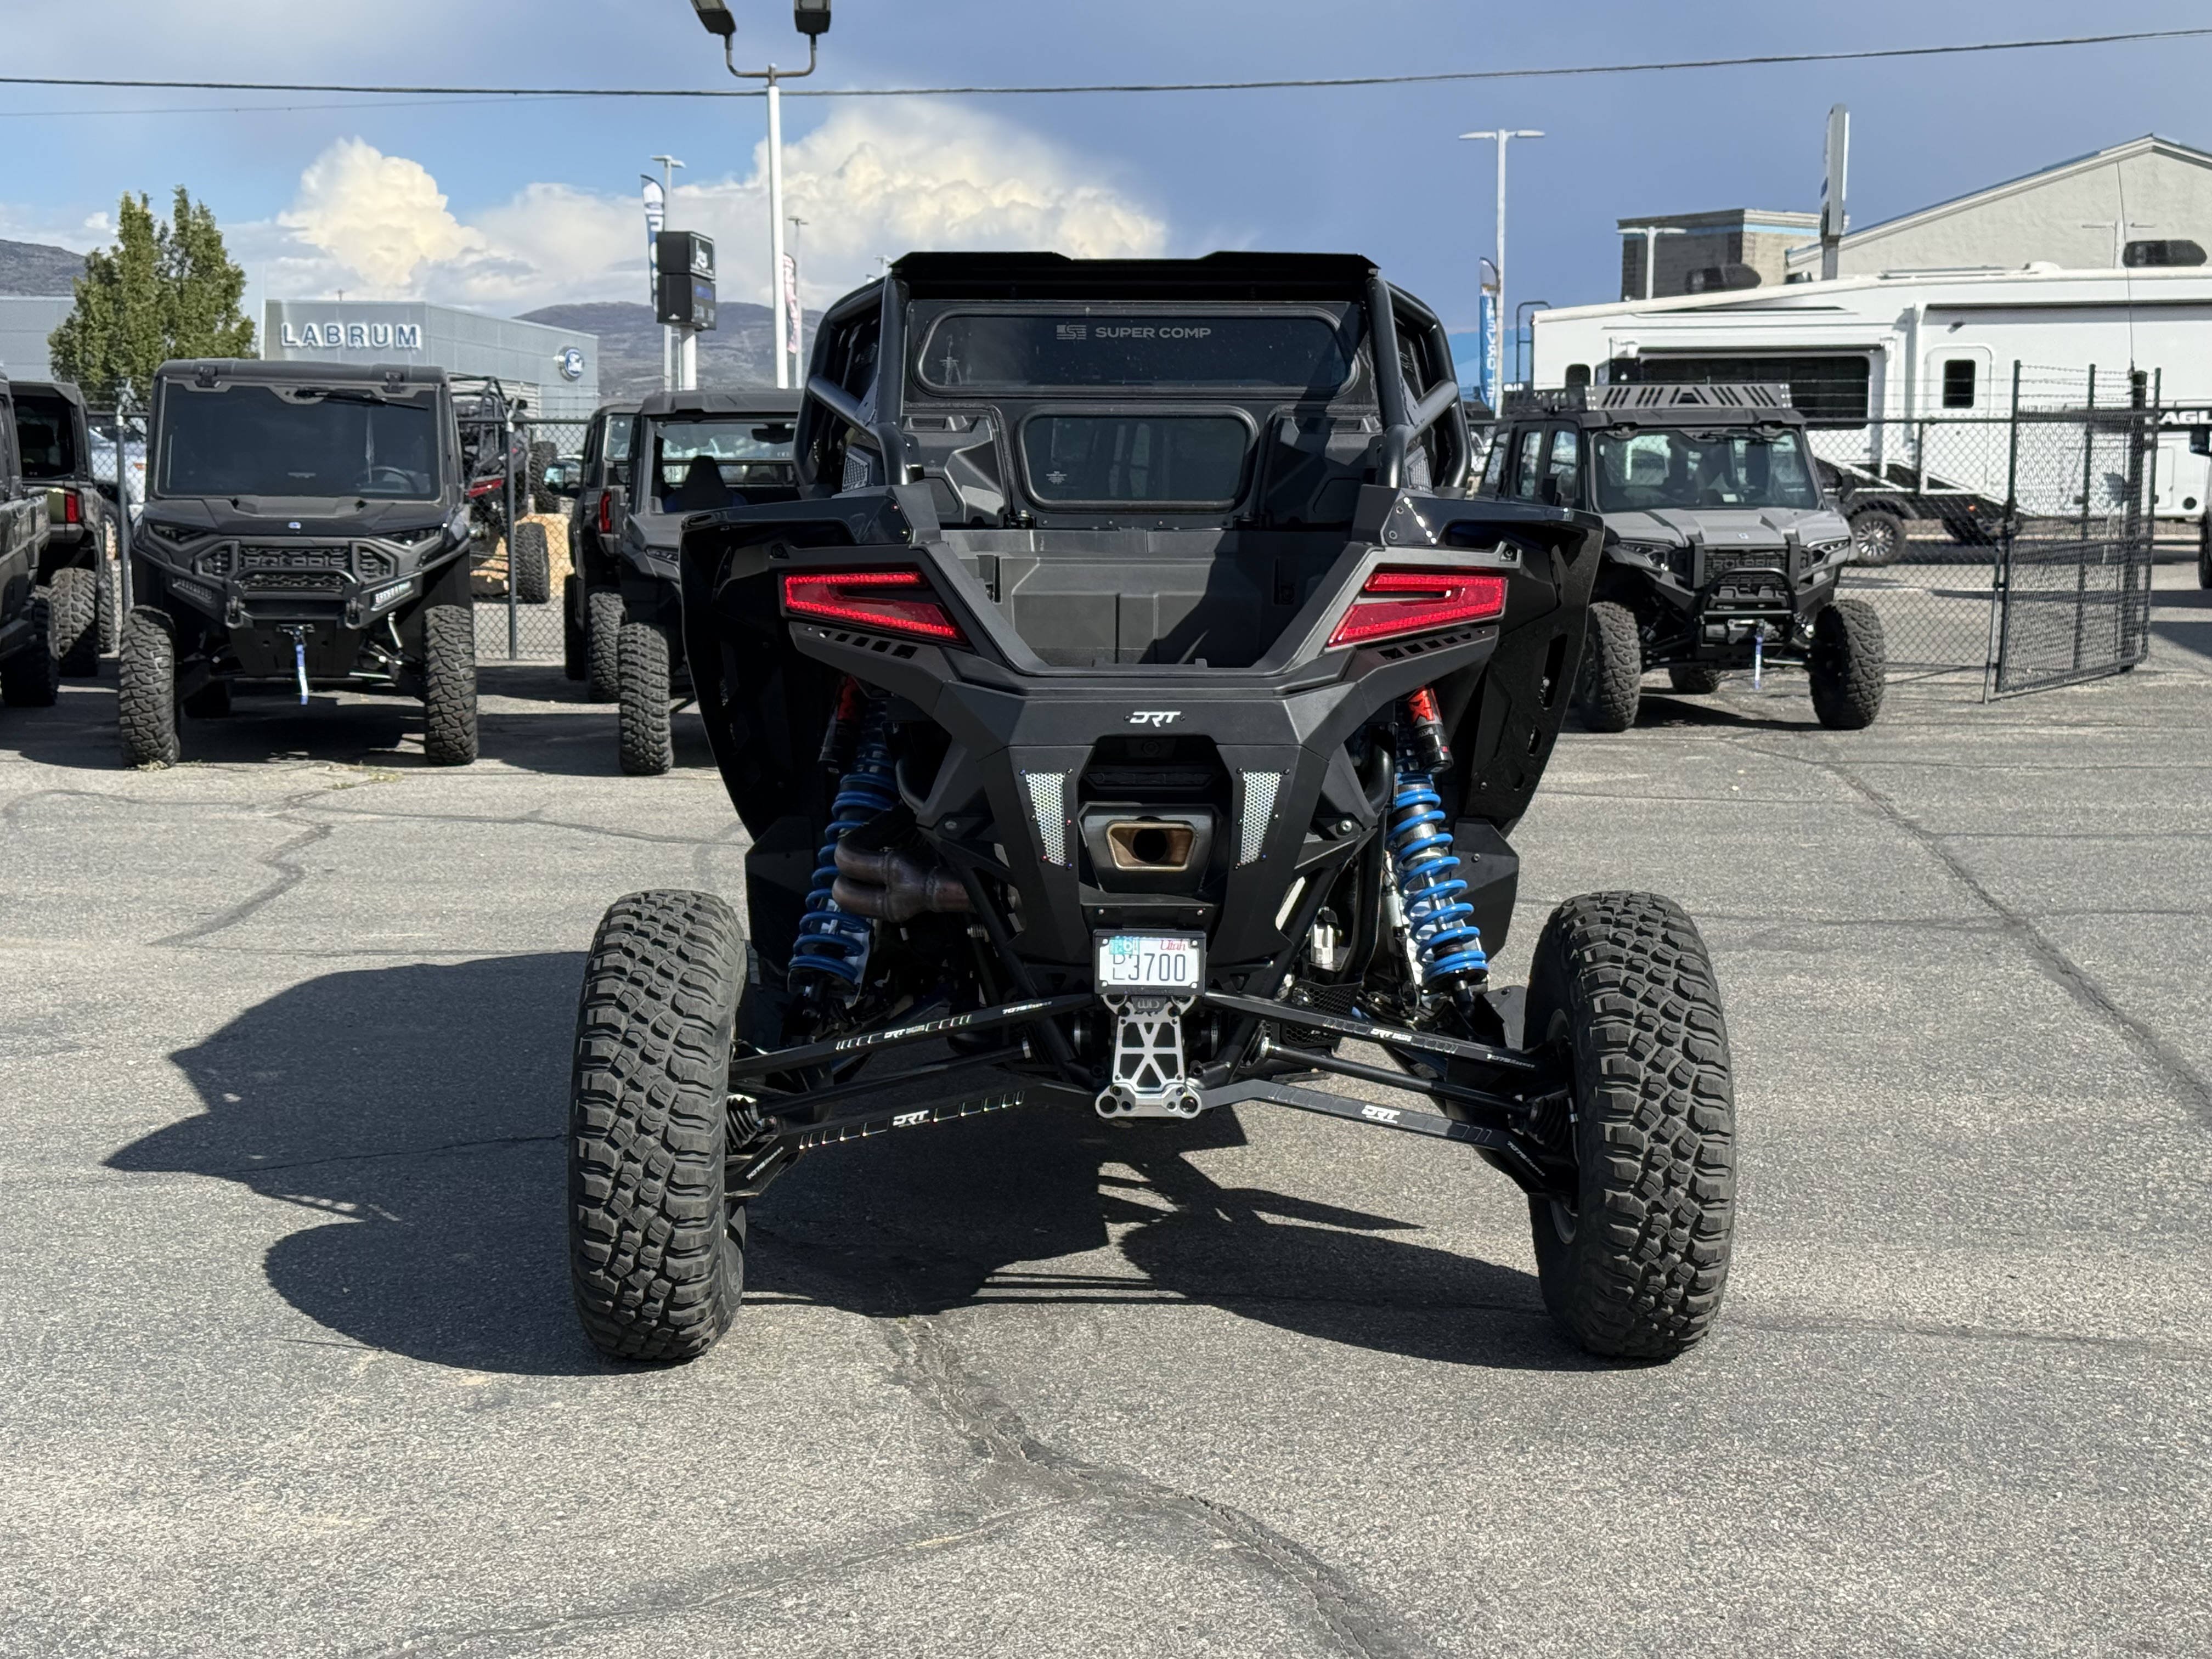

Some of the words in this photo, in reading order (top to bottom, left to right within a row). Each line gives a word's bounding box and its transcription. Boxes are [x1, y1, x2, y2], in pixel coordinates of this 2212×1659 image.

[281, 322, 422, 348] LABRUM
[1095, 327, 1155, 338] SUPER
[1159, 328, 1211, 338] COMP
[245, 556, 347, 568] POLARIS
[1712, 558, 1781, 568] POLARIS
[1130, 711, 1181, 727] DRT
[1160, 939, 1186, 951] Utah
[893, 1110, 929, 1126] DRT
[1362, 1105, 1401, 1121] DRT
